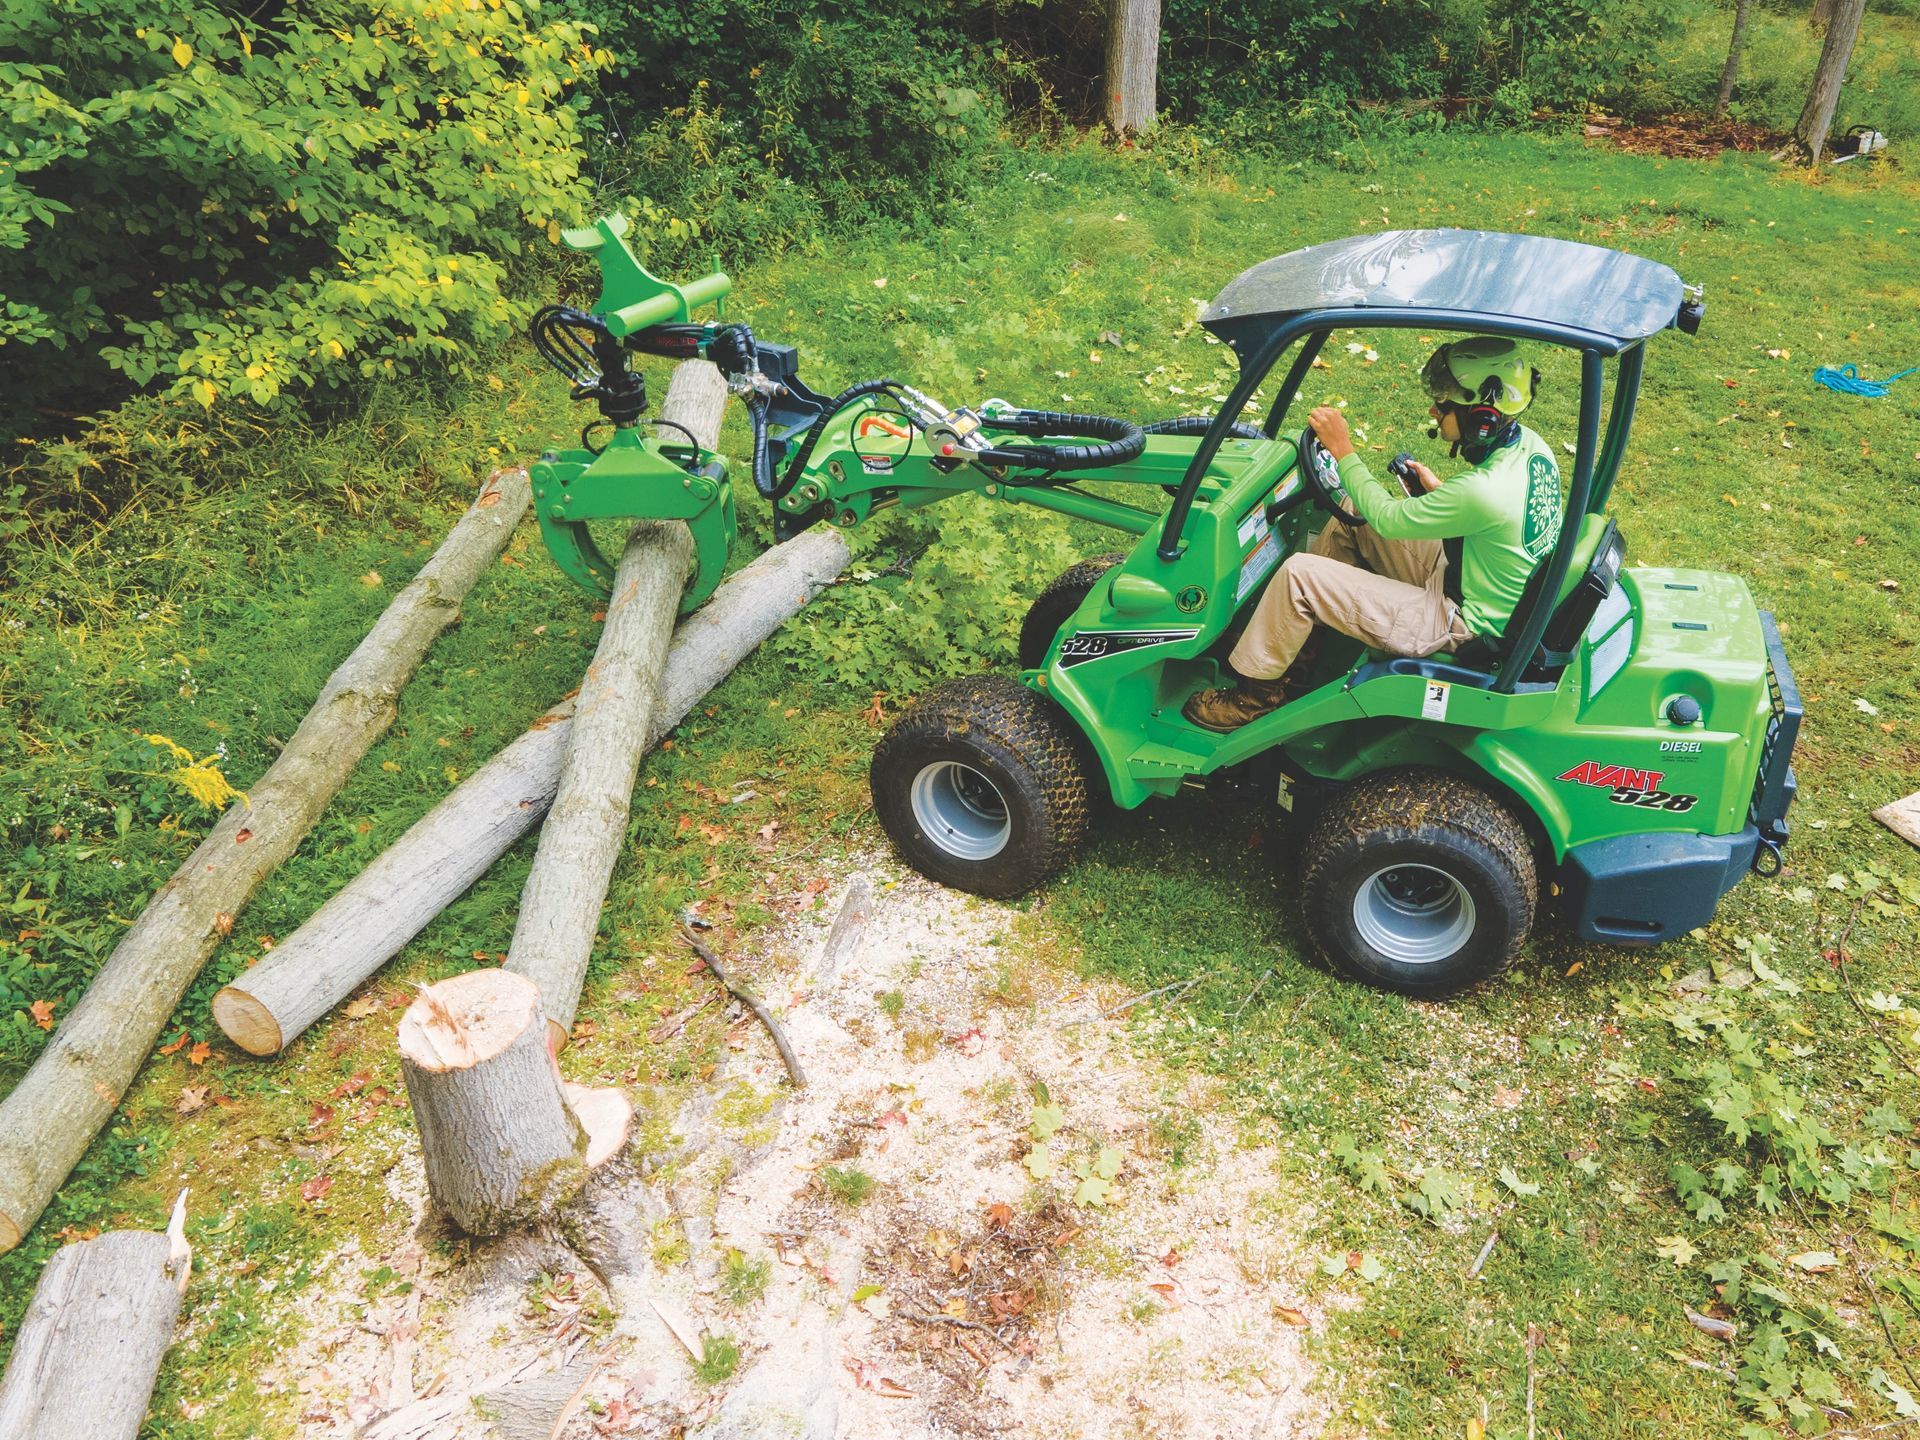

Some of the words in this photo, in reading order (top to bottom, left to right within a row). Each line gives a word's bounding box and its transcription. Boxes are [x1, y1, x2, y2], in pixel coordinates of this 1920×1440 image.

[1061, 637, 1108, 655] 528
[1659, 741, 1702, 753] DIESEL
[1555, 760, 1665, 792] AVANT
[1608, 786, 1699, 813] 528
